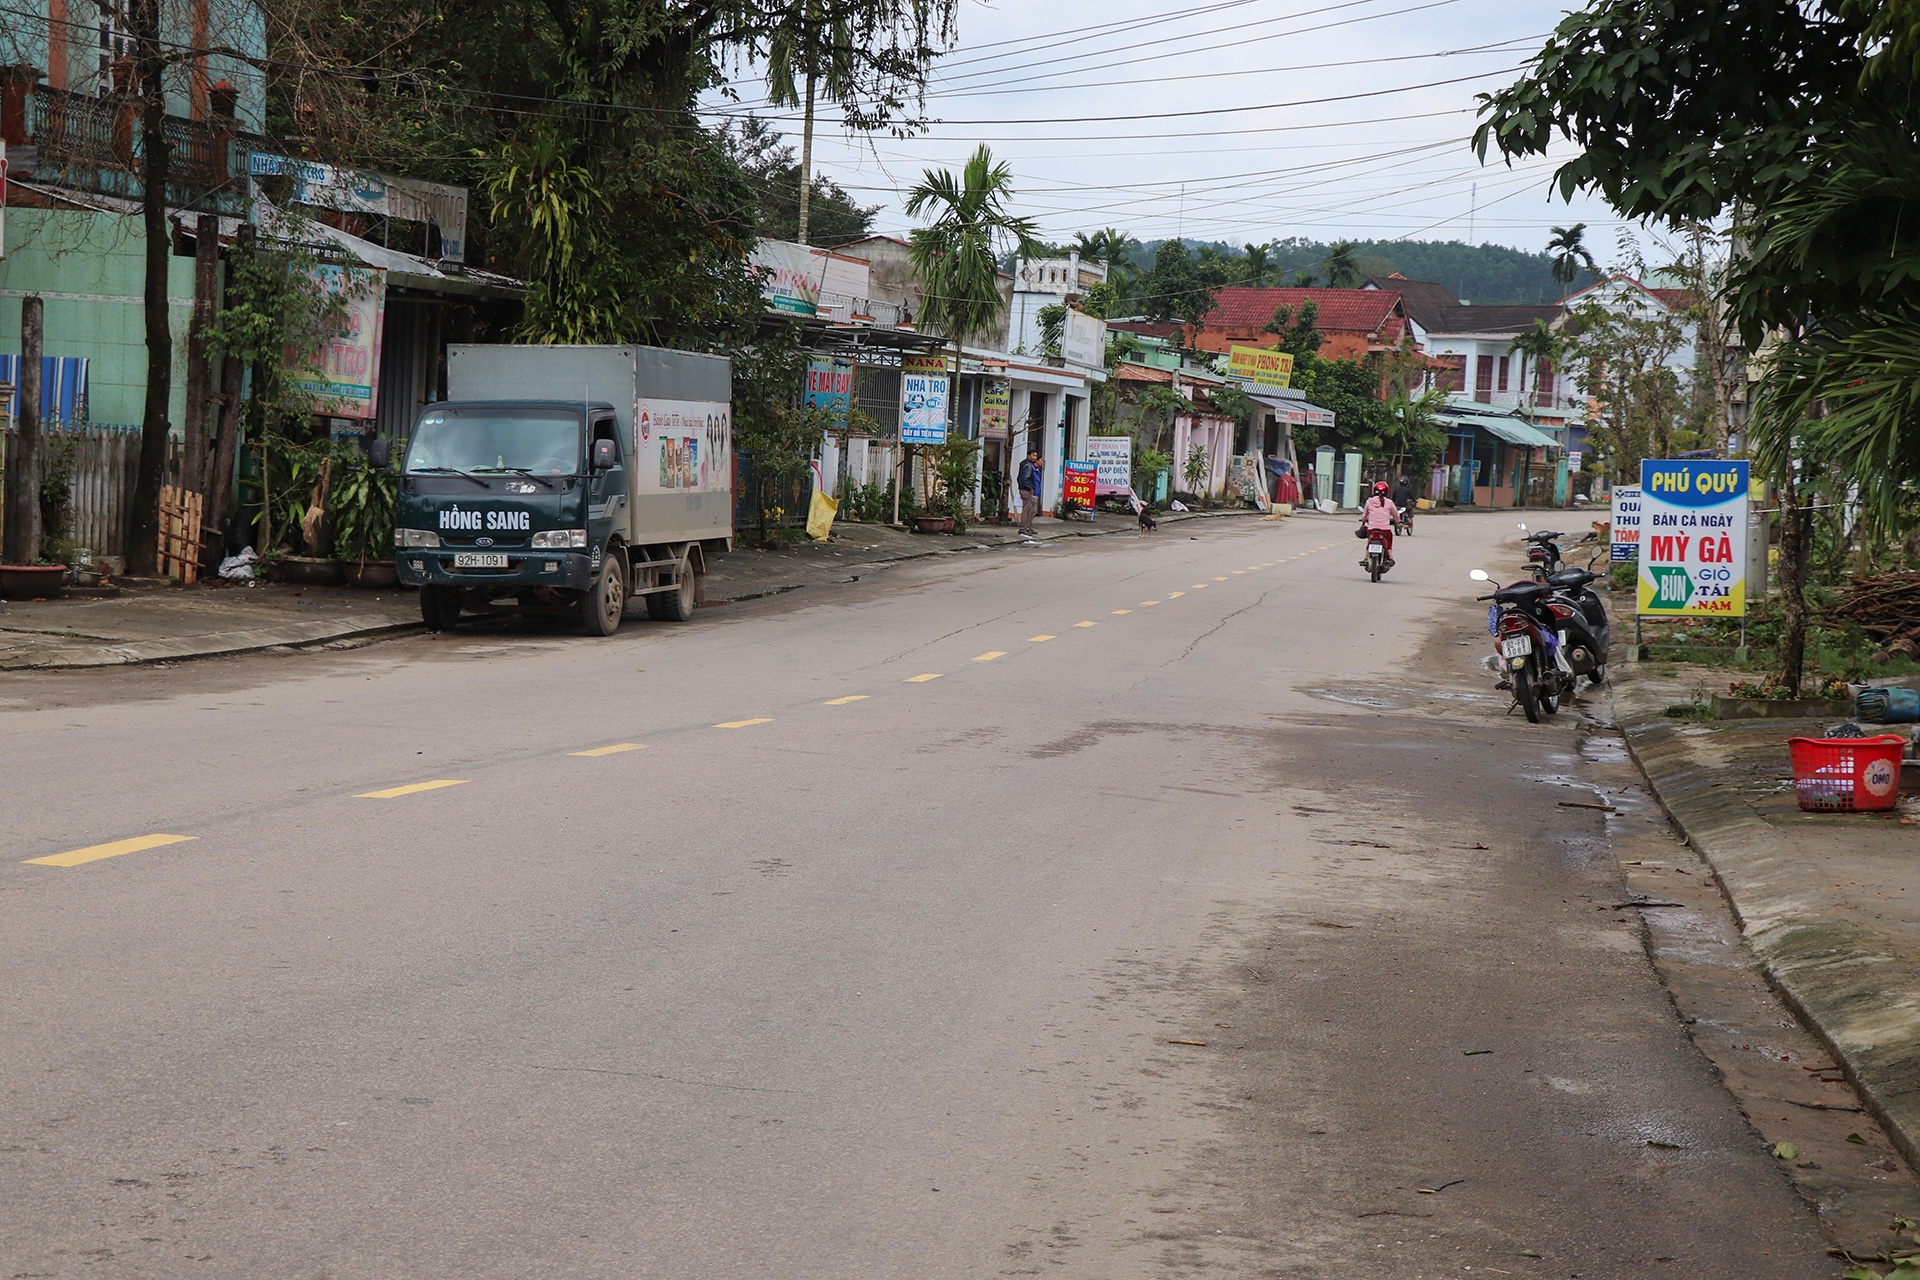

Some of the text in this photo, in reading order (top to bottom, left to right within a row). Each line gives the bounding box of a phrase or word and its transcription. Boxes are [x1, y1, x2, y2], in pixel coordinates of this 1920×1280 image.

[334, 345, 368, 385] TRỌ
[905, 358, 944, 368] NANA
[819, 367, 836, 393] MÁY
[836, 373, 851, 394] BAY
[906, 376, 946, 396] NHÀ TRỌ
[1069, 462, 1094, 470] THANH
[1074, 476, 1087, 484] XE
[1651, 467, 1738, 495] PHÚ QUÝ
[1069, 485, 1090, 495] ĐẠP
[439, 504, 530, 530] HỒNG SANG
[1652, 510, 1734, 527] BÁN CẢ NGÀY
[1650, 530, 1690, 562] MỲ
[1698, 531, 1733, 563] GÀ
[457, 555, 505, 566] 92H-1091
[1698, 565, 1731, 580] GIÒ
[1660, 569, 1687, 601] BÚN
[1872, 773, 1890, 785] OMO
